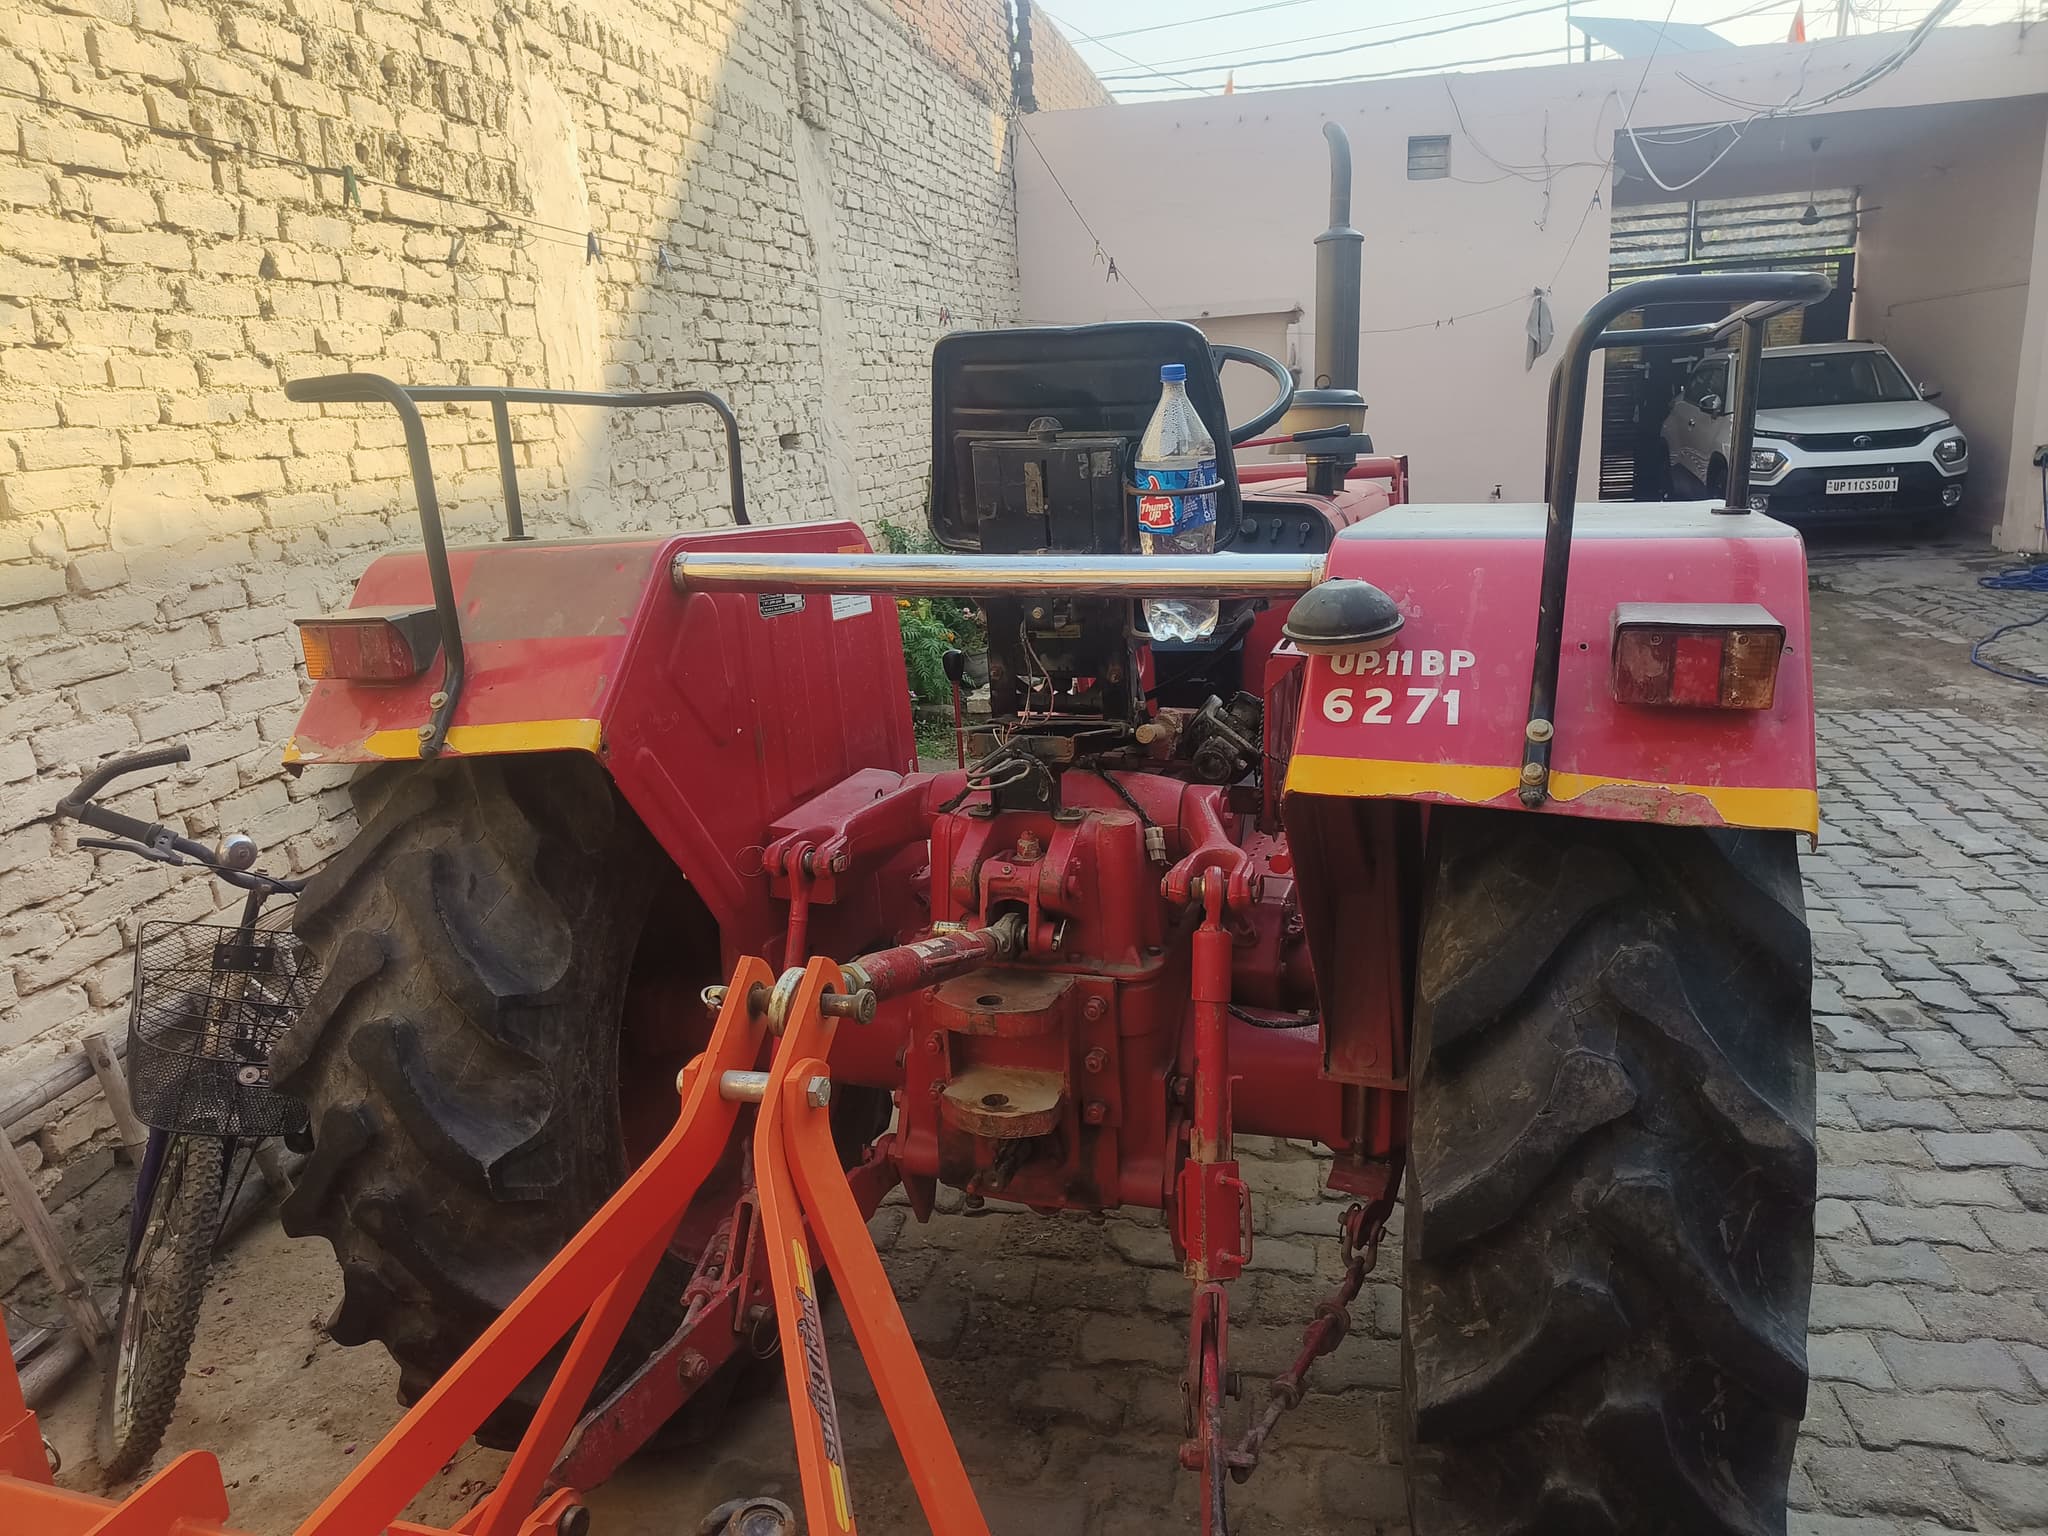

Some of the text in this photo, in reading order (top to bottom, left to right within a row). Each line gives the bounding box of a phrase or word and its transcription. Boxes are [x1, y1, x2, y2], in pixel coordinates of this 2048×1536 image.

[1834, 480, 1897, 491] UP11CS5001
[1141, 503, 1169, 513] Thums
[1322, 687, 1461, 726] 6271
